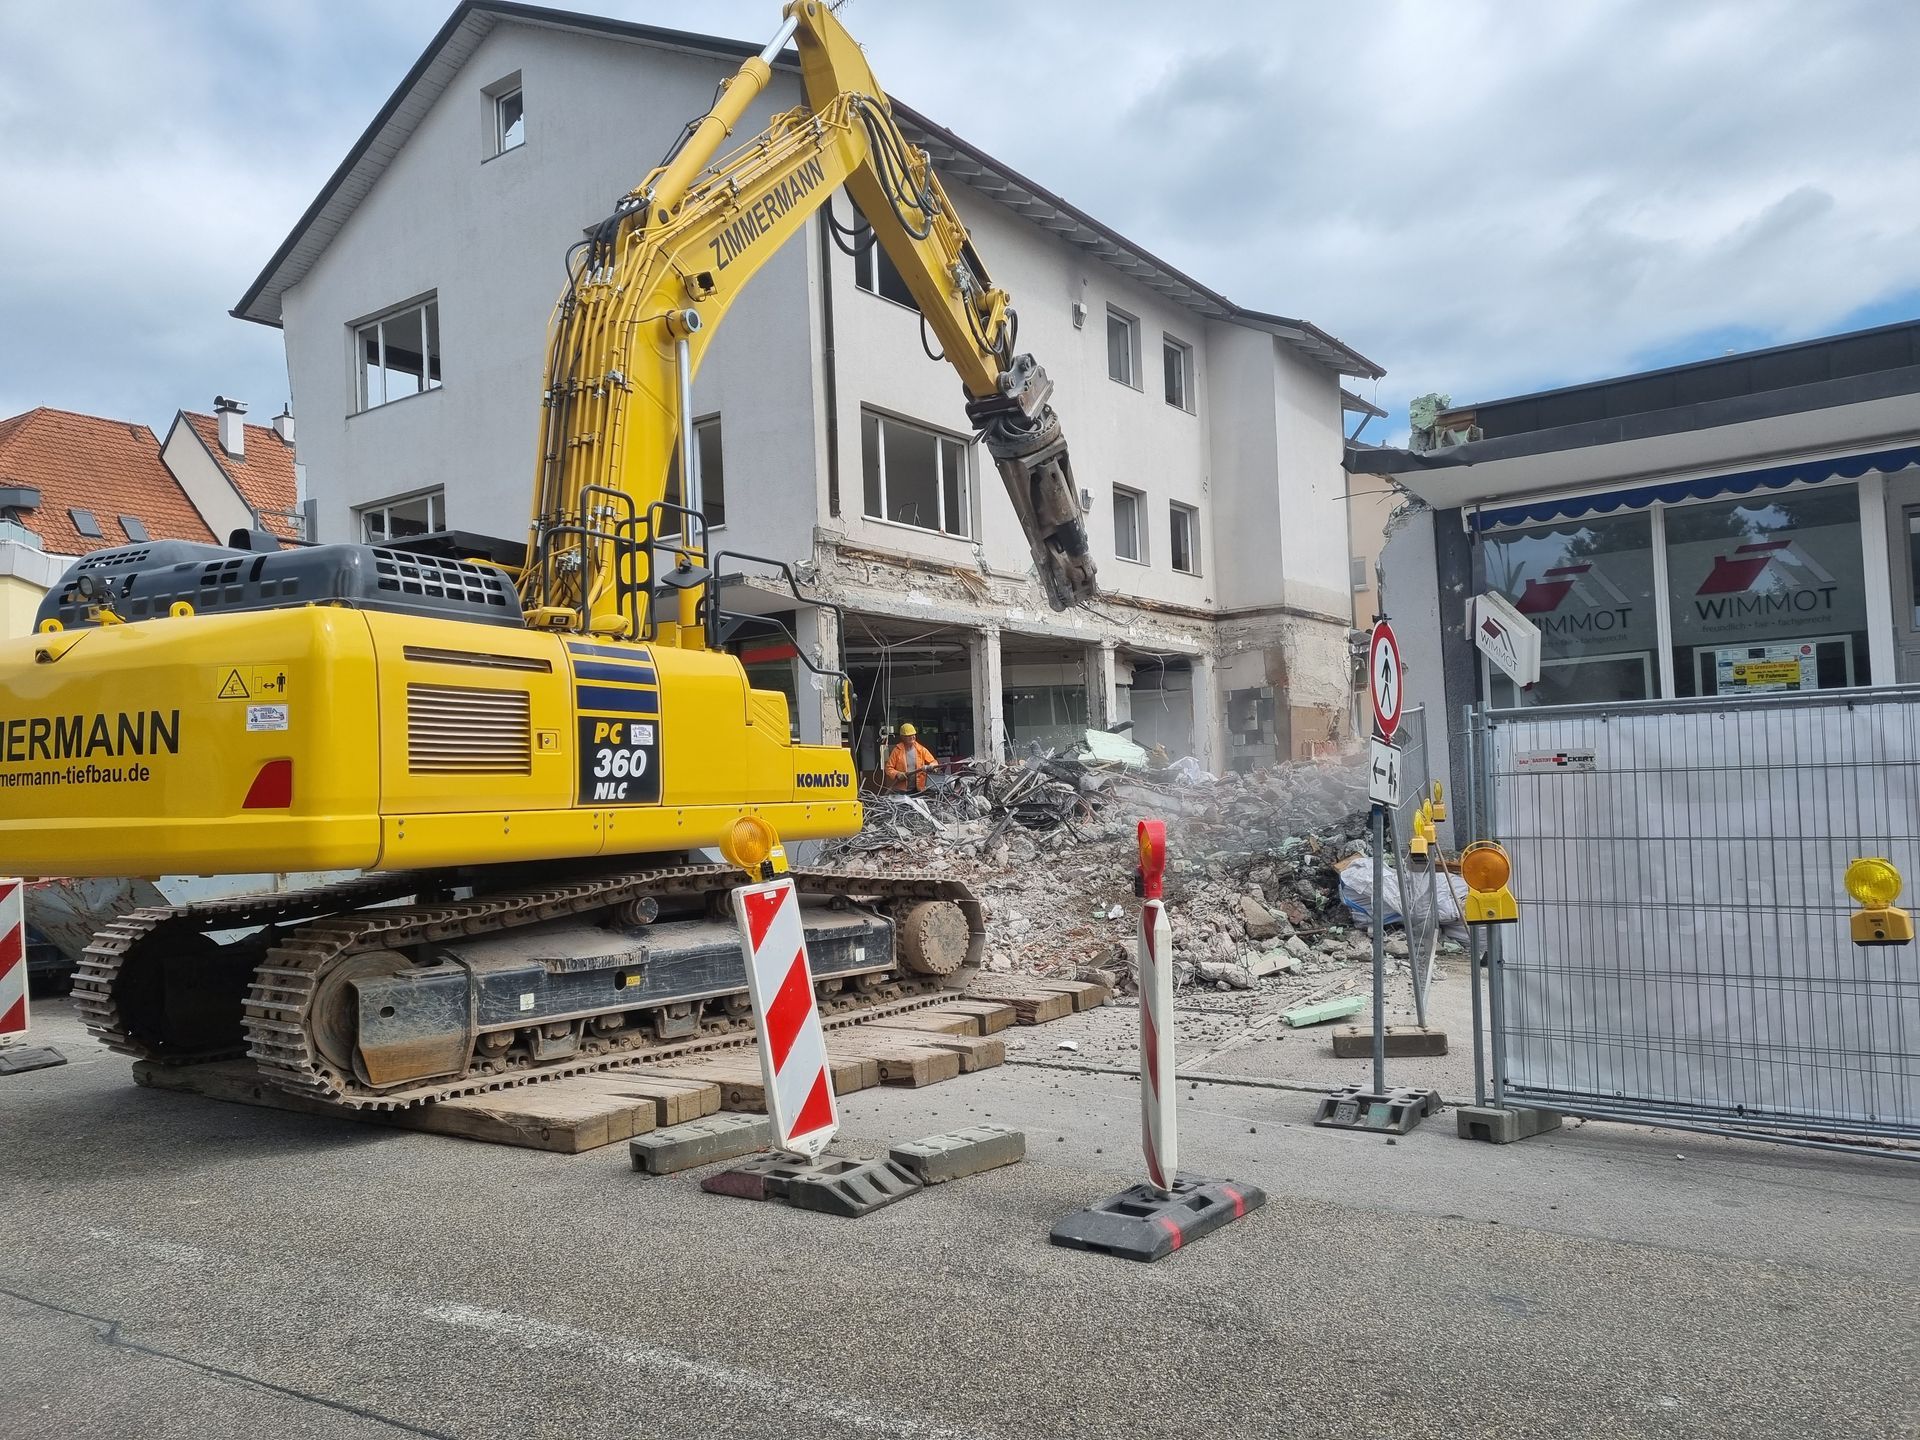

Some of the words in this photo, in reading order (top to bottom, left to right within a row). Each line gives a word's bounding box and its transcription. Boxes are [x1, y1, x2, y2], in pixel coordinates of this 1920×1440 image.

[708, 155, 825, 271] ZIMMERMANN
[1695, 586, 1838, 620] WIMMOT
[1531, 607, 1634, 637] IMMOT
[1480, 630, 1518, 671] WIMMOT
[0, 709, 180, 763] ERMANN
[593, 721, 623, 745] PC
[593, 748, 647, 778] 360
[593, 782, 628, 800] NLC
[796, 769, 850, 788] KOMATSU
